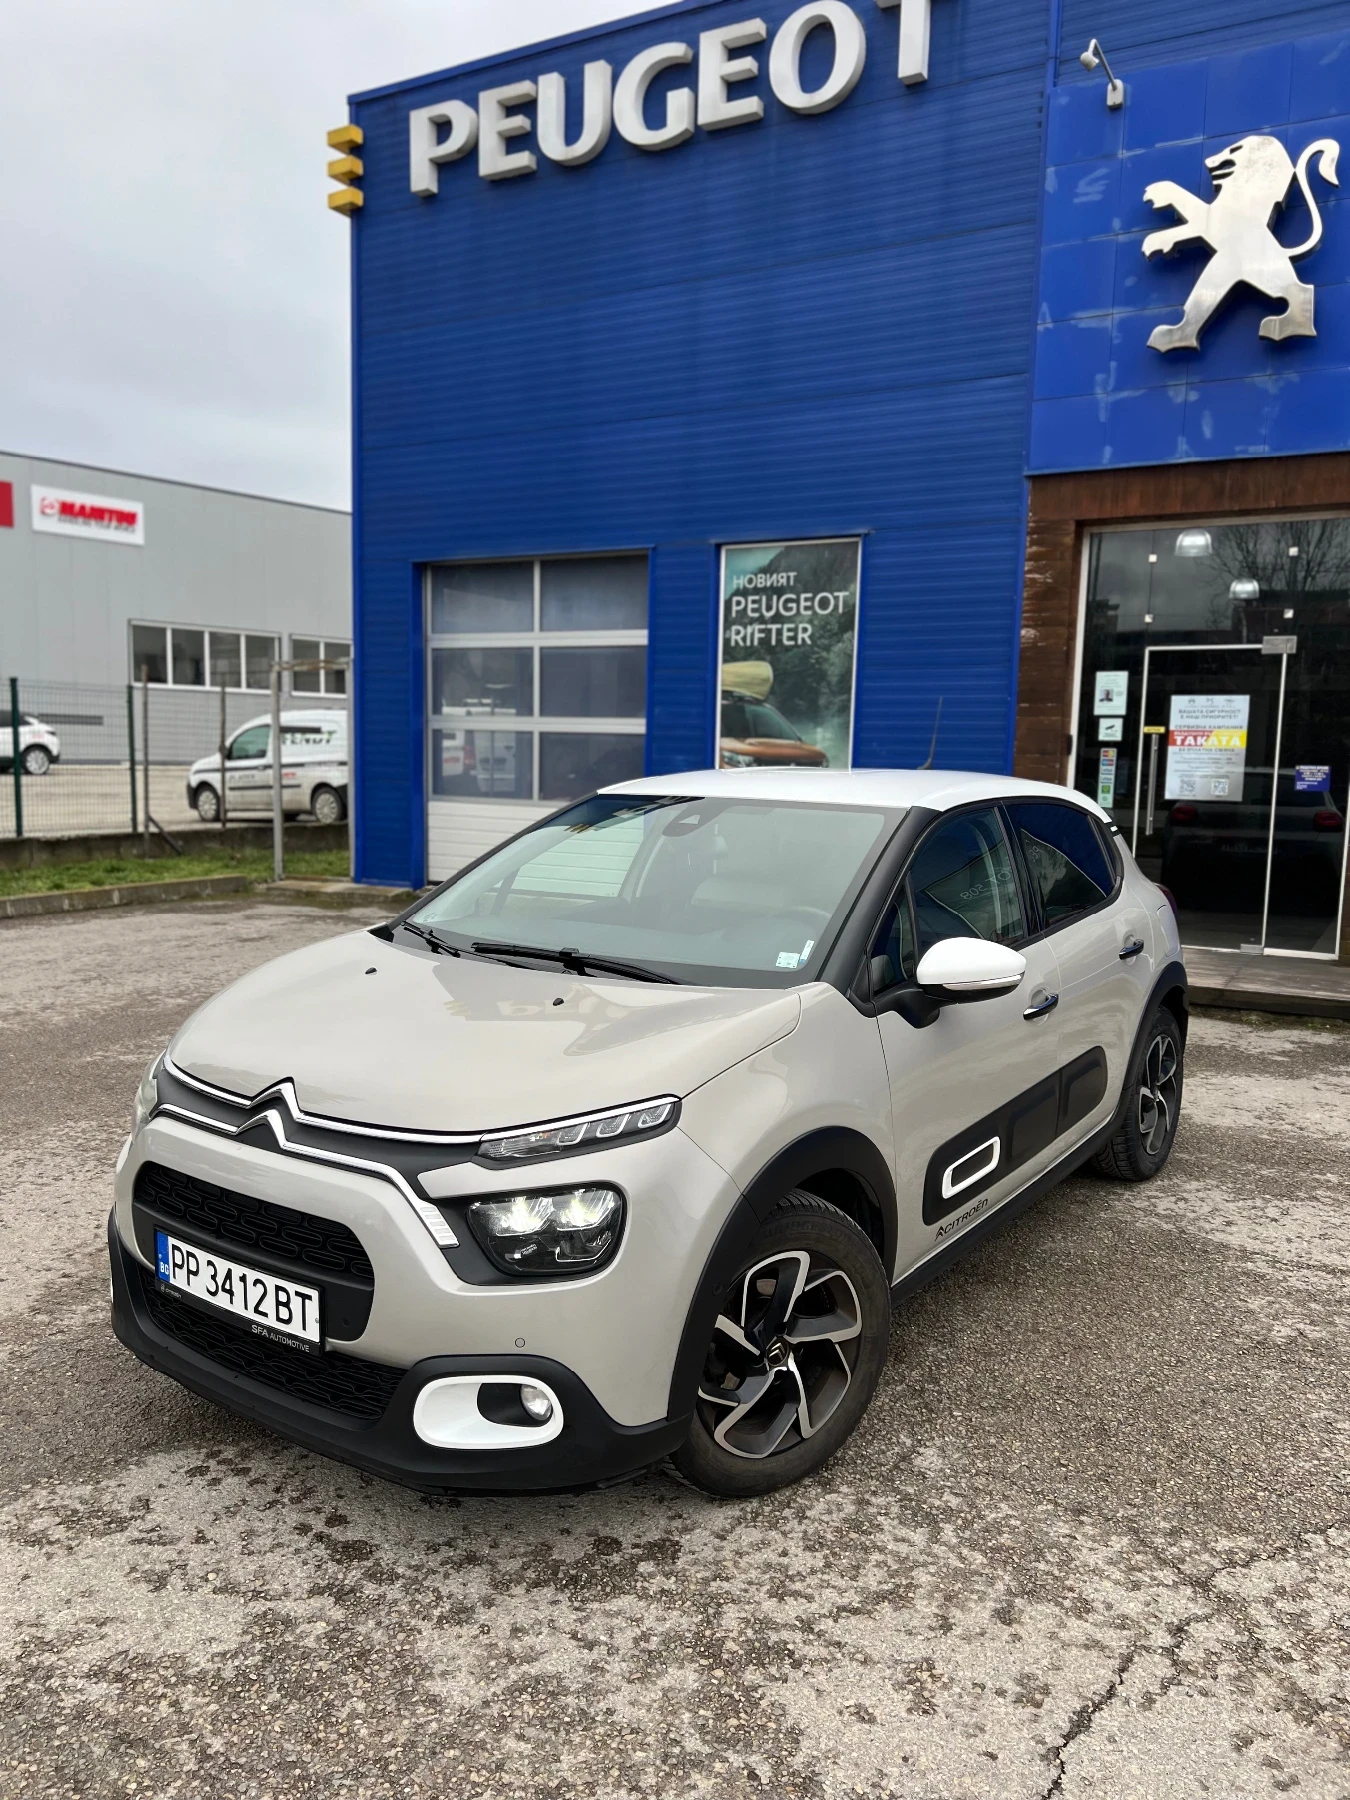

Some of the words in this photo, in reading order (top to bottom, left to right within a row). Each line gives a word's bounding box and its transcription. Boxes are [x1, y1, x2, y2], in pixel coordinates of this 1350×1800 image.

[409, 0, 932, 197] PEUGEOT
[732, 571, 797, 588] НОВИЯТ
[731, 591, 850, 618] PEUGEOT
[730, 622, 813, 648] RIFTER
[160, 1261, 170, 1275] BG
[205, 1259, 269, 1319] 3412
[251, 1324, 269, 1337] SFA
[269, 1332, 310, 1353] AUTOMOTIVE
